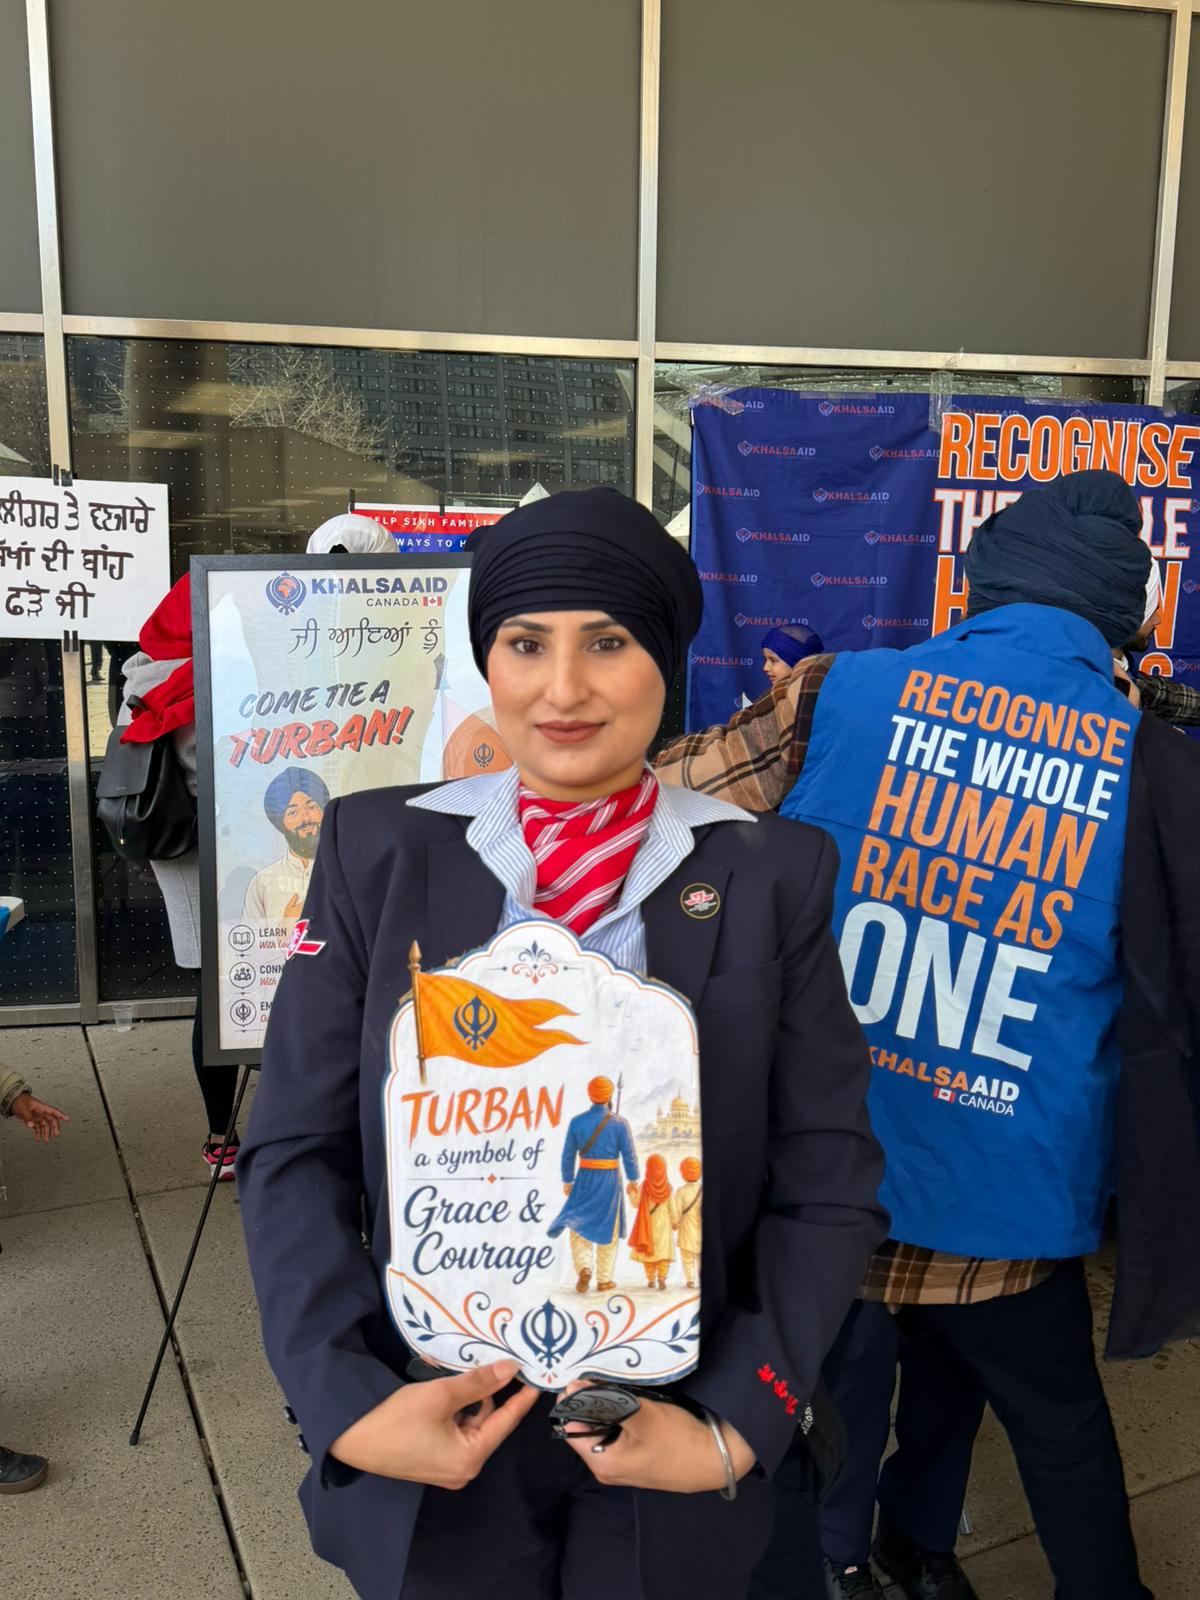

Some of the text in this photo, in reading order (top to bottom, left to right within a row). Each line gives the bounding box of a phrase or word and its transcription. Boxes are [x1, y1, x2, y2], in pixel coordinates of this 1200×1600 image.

[938, 412, 1200, 488] RECOGNISE
[370, 516, 397, 525] ELP
[404, 517, 434, 526] SIKH
[437, 539, 453, 547] TO
[935, 488, 1023, 553] TH
[41, 539, 75, 572] ਦੀ
[55, 582, 96, 619] ਜੀ
[366, 597, 419, 607] CANADA
[288, 617, 320, 659] ਜੀ
[238, 679, 391, 719] COME TIE A
[898, 669, 1130, 766] RECOGNISE
[227, 706, 415, 768] TURBAN!
[887, 714, 1120, 821] THE WHOLE
[867, 764, 1100, 890] HUMAN
[852, 834, 1074, 950] RACE AS
[259, 928, 287, 938] LEARN
[838, 901, 1053, 1073] ONE
[401, 1083, 565, 1148] TURBAN
[958, 1093, 1015, 1117] CANADA
[414, 1138, 545, 1174] a symbol of
[404, 1185, 545, 1237] Grace &
[413, 1231, 556, 1285] Courage
